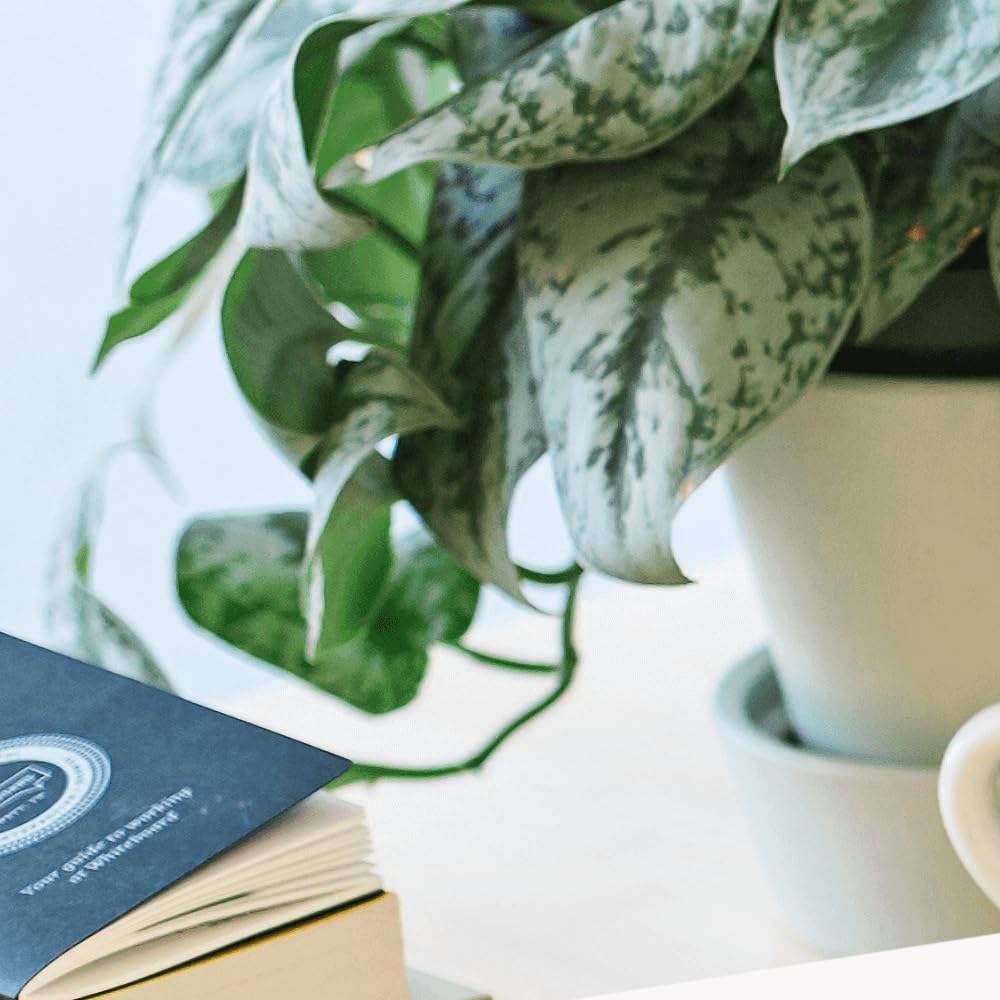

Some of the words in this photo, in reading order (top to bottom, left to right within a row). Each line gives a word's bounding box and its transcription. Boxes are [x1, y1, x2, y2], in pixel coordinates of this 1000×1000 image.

[18, 869, 60, 896] Your
[61, 841, 107, 873] guide
[105, 828, 126, 844] to
[124, 785, 194, 830] working
